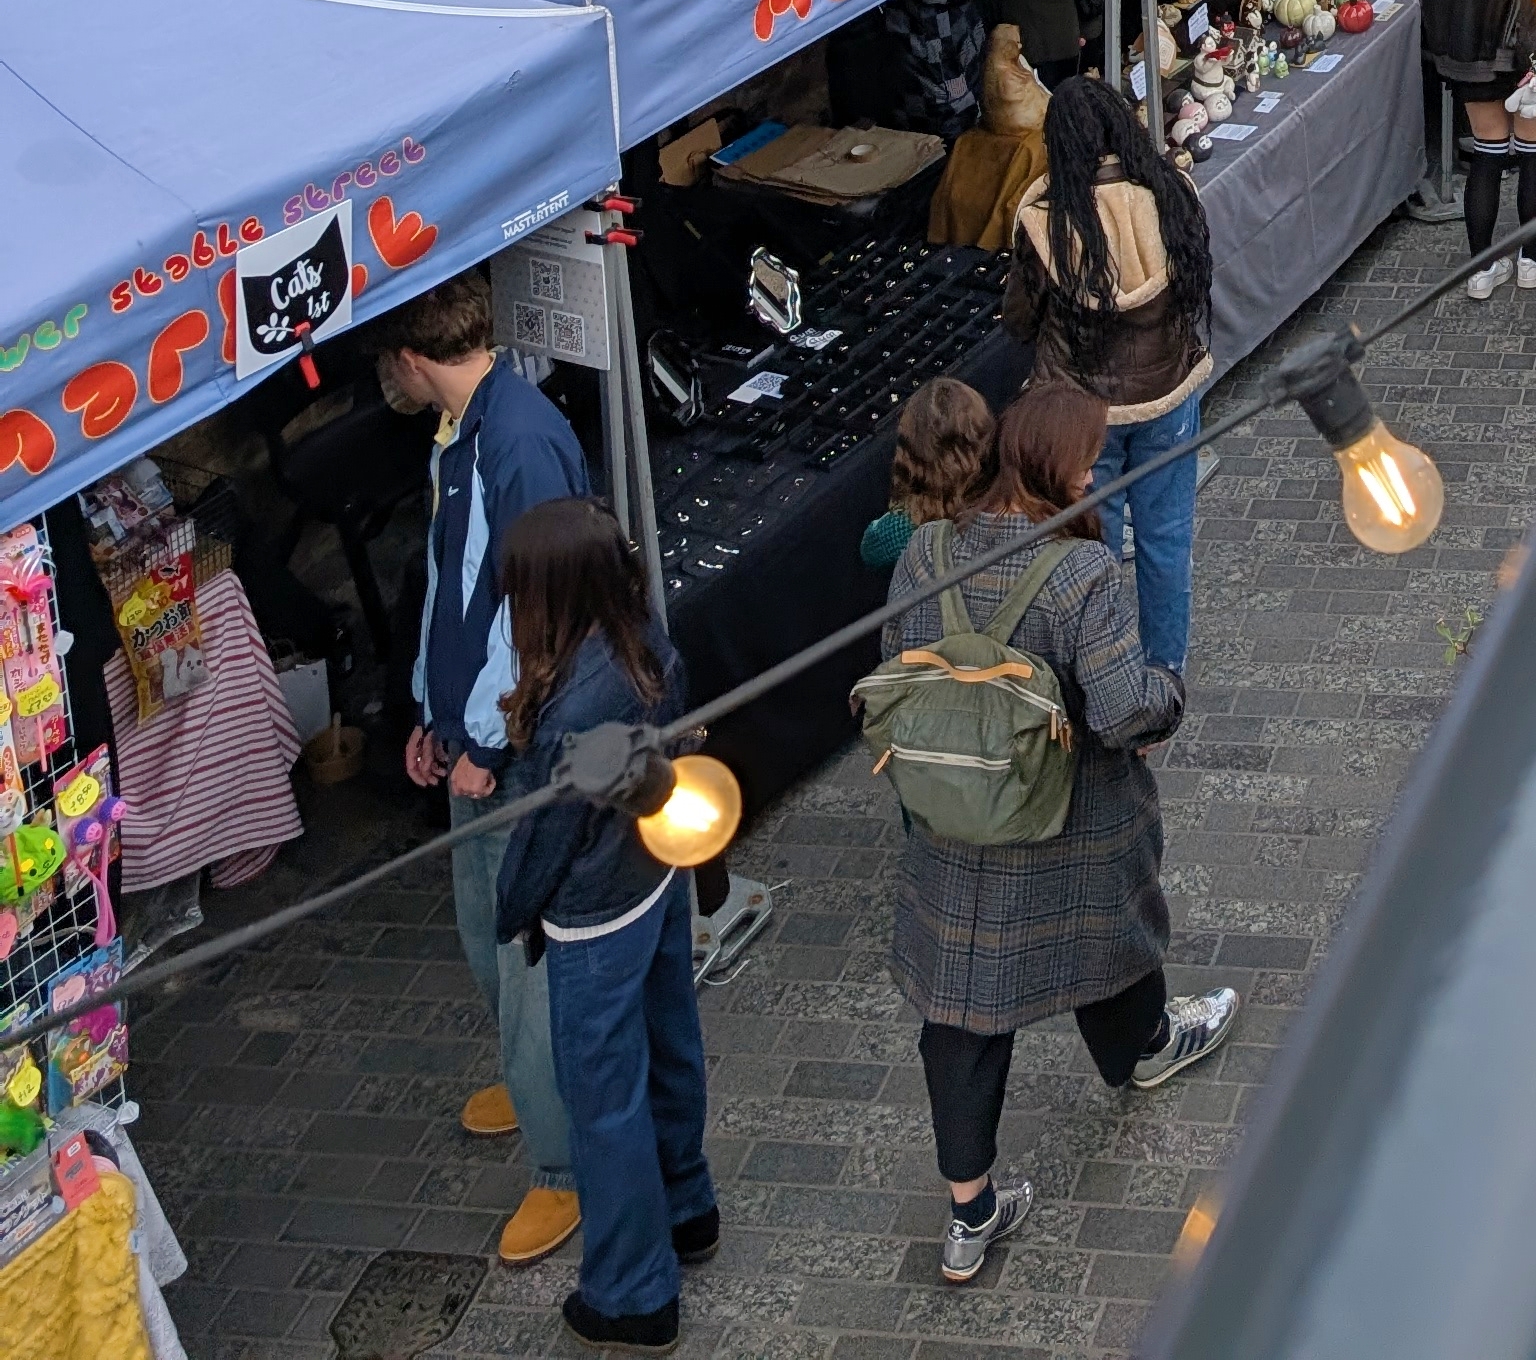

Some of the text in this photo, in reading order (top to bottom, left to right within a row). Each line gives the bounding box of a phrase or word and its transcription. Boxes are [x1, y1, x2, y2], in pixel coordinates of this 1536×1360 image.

[110, 214, 265, 314] stable
[283, 136, 426, 226] street
[501, 190, 570, 240] MASTERTENT
[270, 258, 324, 310] Cats
[306, 290, 331, 320] 1st
